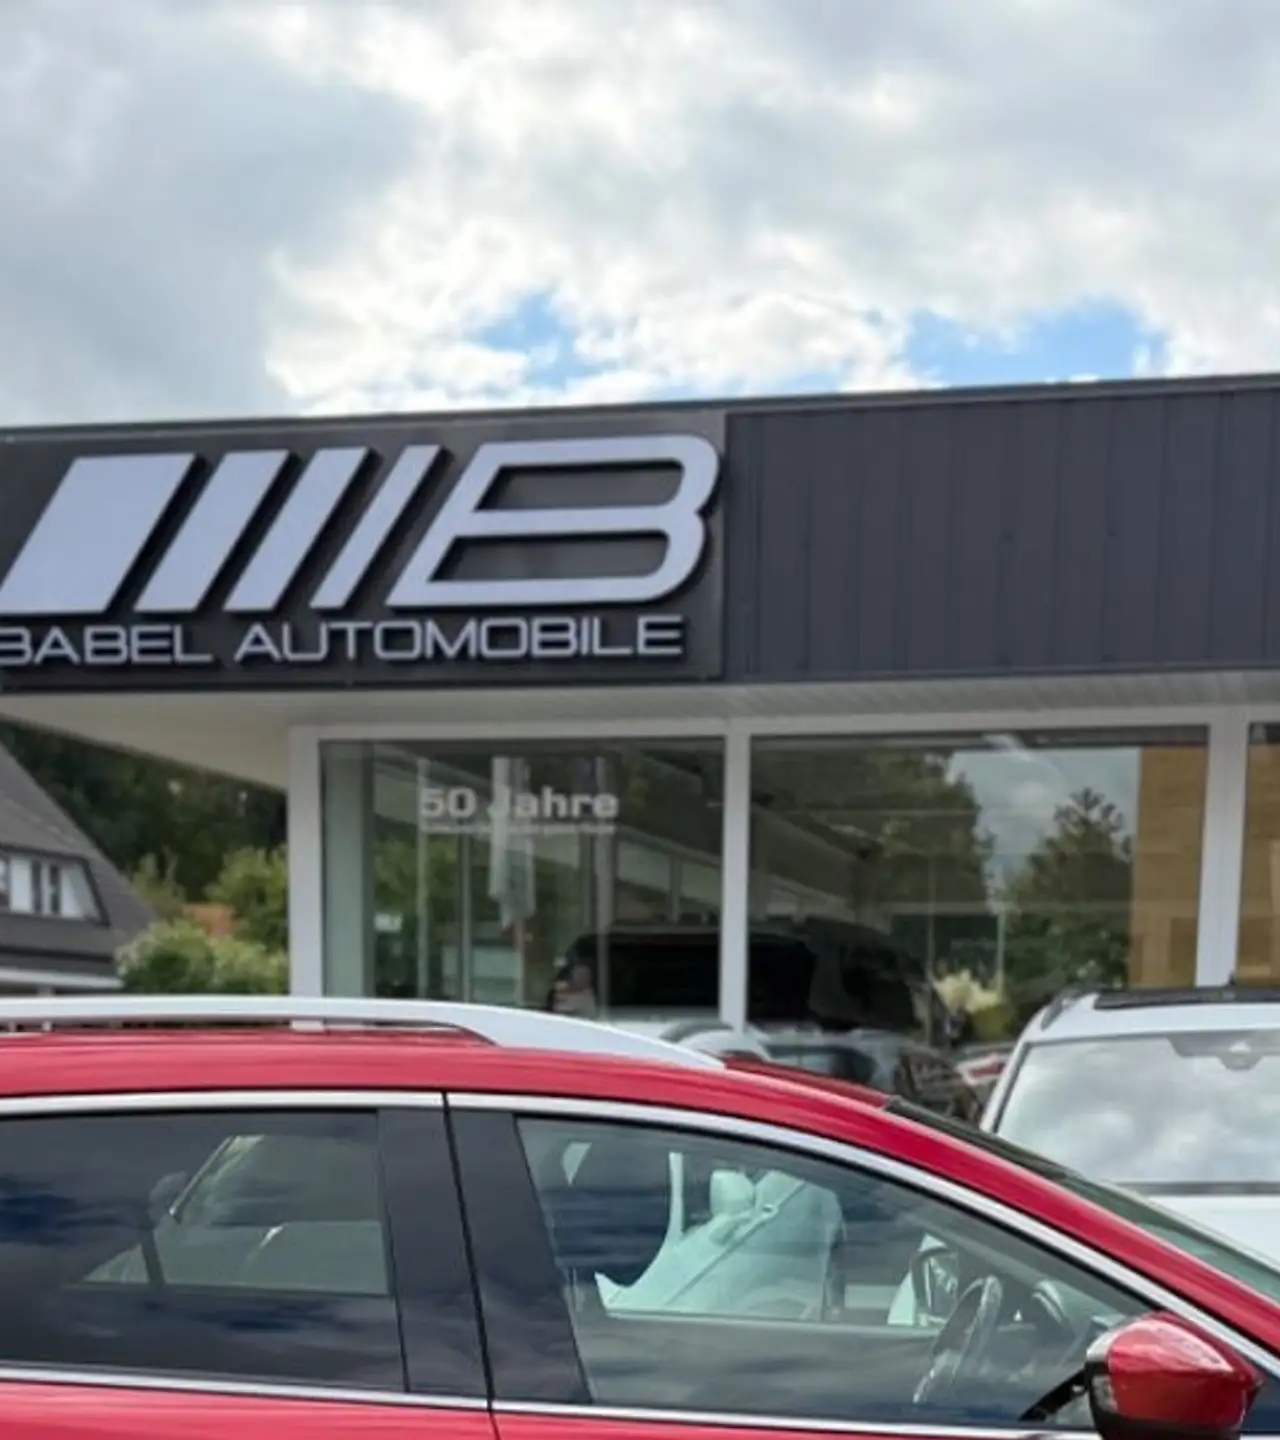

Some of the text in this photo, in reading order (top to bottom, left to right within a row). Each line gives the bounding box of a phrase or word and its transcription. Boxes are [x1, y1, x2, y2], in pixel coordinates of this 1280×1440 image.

[234, 614, 686, 665] AUTOMOBILE
[421, 784, 619, 819] 50 Jahre
